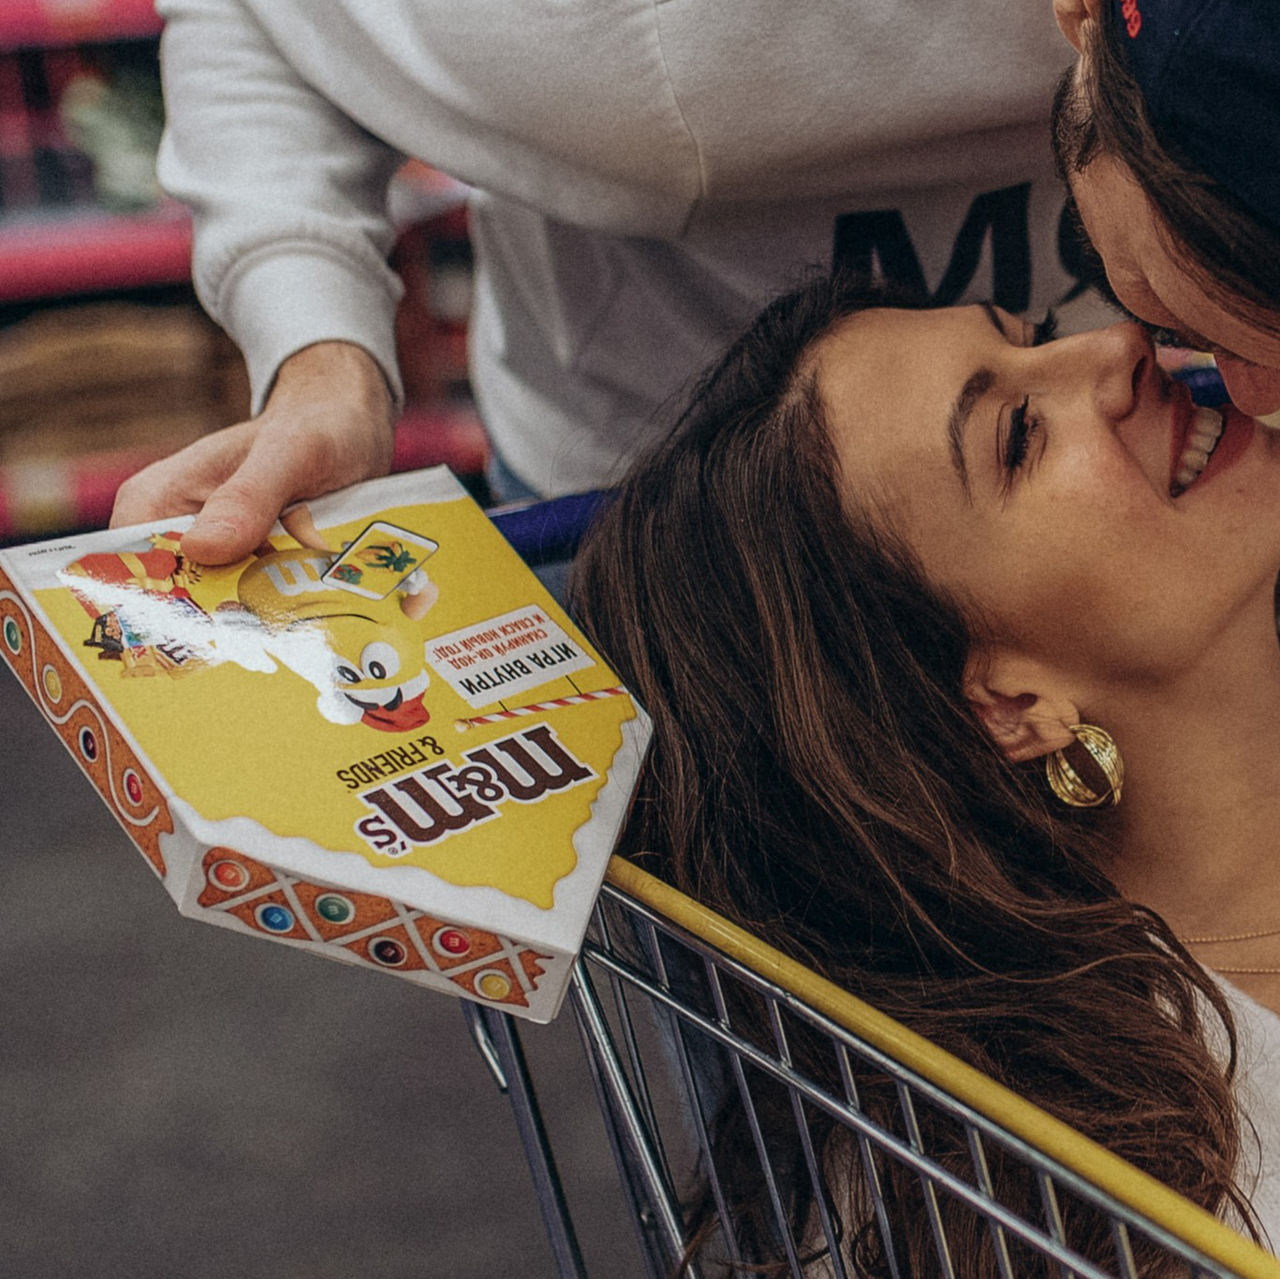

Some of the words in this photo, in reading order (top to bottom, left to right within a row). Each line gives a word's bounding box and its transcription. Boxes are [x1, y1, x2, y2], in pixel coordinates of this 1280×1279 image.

[498, 617, 536, 634] СПАСИ
[532, 613, 546, 624] И
[459, 627, 501, 652] НОВЫЙ
[491, 628, 549, 657] СКАНИРУЙ
[448, 647, 495, 670] QR-КОД
[526, 641, 579, 670] ИГРА
[458, 662, 534, 696] ВНУТРИ
[416, 735, 446, 756] &
[336, 742, 430, 790] FRIENDS
